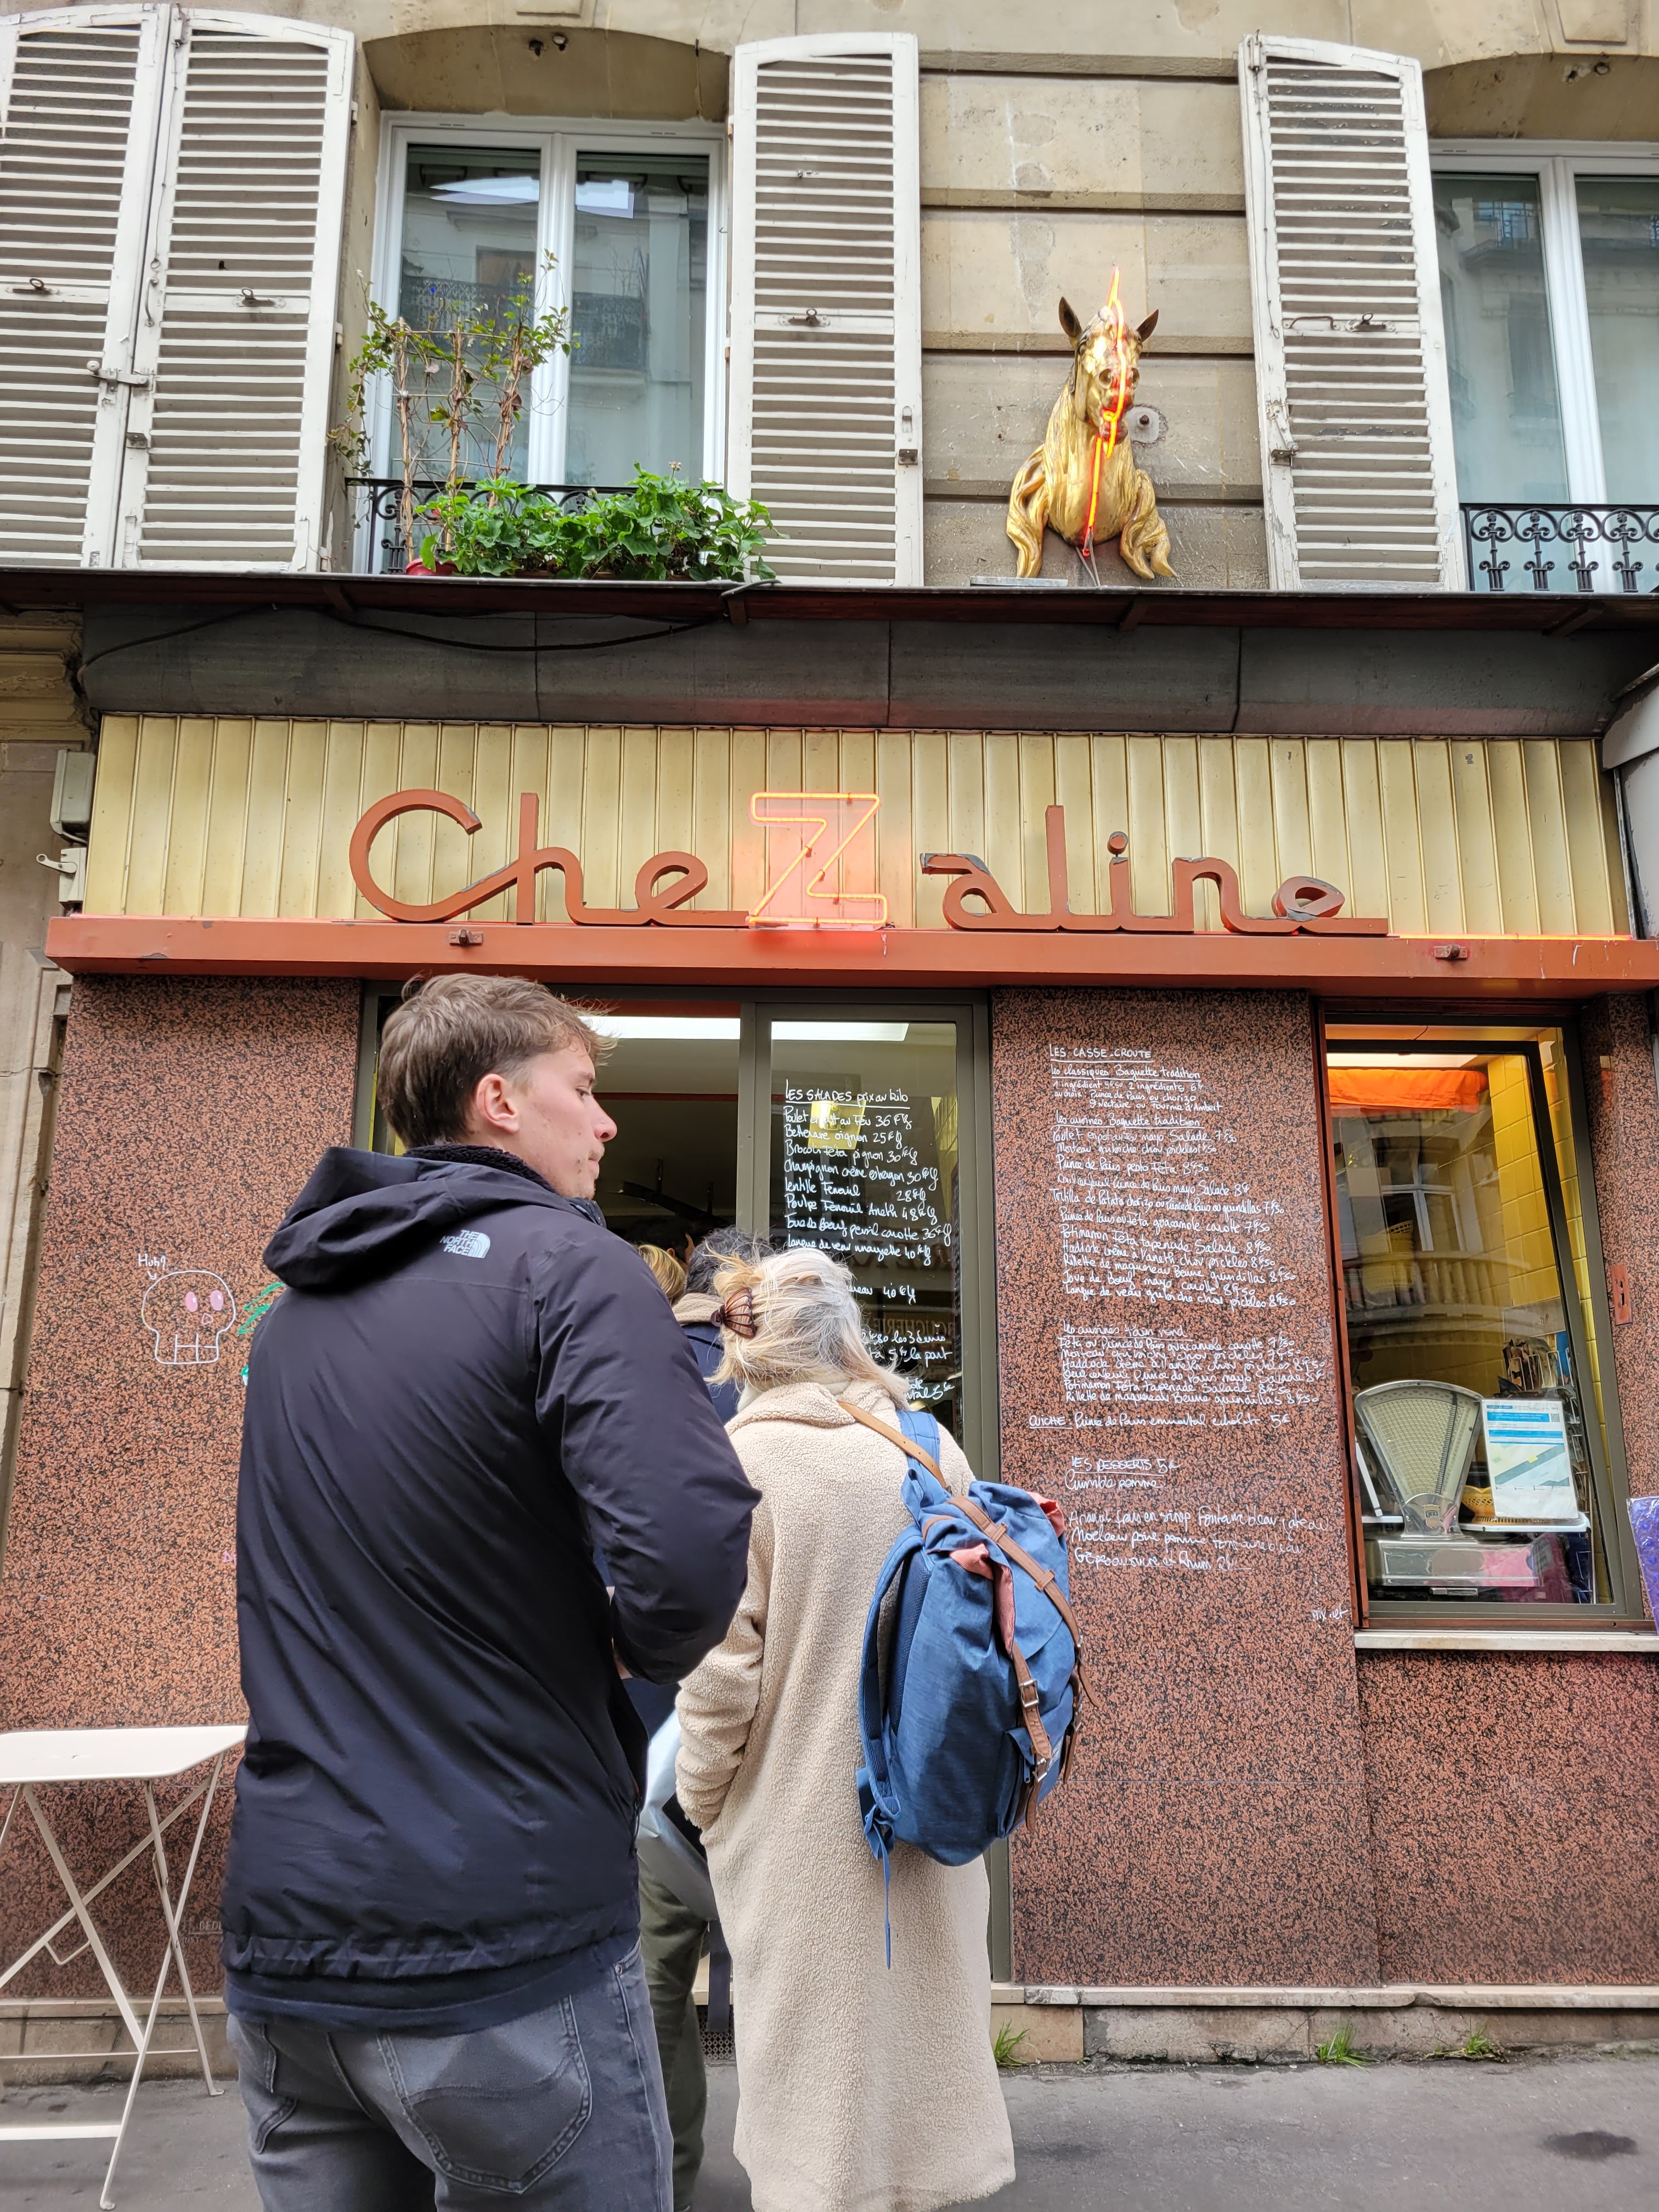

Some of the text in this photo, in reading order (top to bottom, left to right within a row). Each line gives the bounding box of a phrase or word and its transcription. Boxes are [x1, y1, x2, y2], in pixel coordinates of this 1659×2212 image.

[1049, 1043, 1066, 1058] LES
[1064, 1064, 1200, 1082] classiques Baguette tradition
[785, 1079, 909, 1108] LES SALADES prix au kilo
[1053, 1080, 1059, 1088] 1
[1060, 1080, 1103, 1092] ingrédient
[1137, 1082, 1185, 1094] ingrédients
[1098, 1099, 1131, 1108] Nectaire
[1185, 1101, 1223, 1113] d'Ambert
[1114, 1090, 1124, 1099] de
[1126, 1091, 1146, 1101] Paris
[1163, 1091, 1196, 1105] chorizo
[783, 1105, 809, 1123] Poulet
[840, 1117, 851, 1125] au
[853, 1114, 871, 1126] Feu
[1108, 1112, 1200, 1130] Baguette tradition
[784, 1123, 868, 1148] Betterave oignon
[1051, 1127, 1085, 1142] Poulet
[1142, 1133, 1164, 1146] mayo
[1169, 1130, 1212, 1142] Salade
[1057, 1142, 1198, 1156] Morteau chou pickles
[853, 1148, 883, 1169] pignon
[1085, 1158, 1098, 1170] de
[1099, 1157, 1120, 1171] Paris
[785, 1159, 905, 1187] Champignon crème estragon
[821, 1181, 861, 1197] Fenouil
[1140, 1178, 1150, 1189] de
[1173, 1185, 1196, 1199] mayo
[1197, 1180, 1229, 1197] Salade
[784, 1193, 817, 1212] Poulpe
[868, 1202, 898, 1218] Aneth
[1048, 1187, 1081, 1203] Tortilla
[1084, 1188, 1096, 1204] de
[1098, 1189, 1125, 1207] Patata
[1126, 1194, 1154, 1214] chorizo
[1212, 1203, 1221, 1211] ou
[1221, 1199, 1262, 1222] guindillas
[806, 1217, 919, 1240] de persil carotte
[1085, 1209, 1094, 1222] de
[1096, 1208, 1115, 1224] Paris
[1116, 1215, 1126, 1223] ou
[1153, 1216, 1201, 1235] guacamole
[1206, 1216, 1240, 1233] carotte
[439, 1235, 475, 1248] NORTH
[460, 1229, 480, 1240] THE
[443, 1244, 471, 1256] FACE
[819, 1239, 851, 1251] de veau
[1140, 1233, 1192, 1251] tapenade
[1194, 1238, 1240, 1255] Salade
[138, 1253, 166, 1270] Huh?
[1180, 1252, 1204, 1266] chou
[1209, 1255, 1248, 1269] pickles
[1064, 1252, 1097, 1267] Rillette
[1099, 1258, 1112, 1269] de
[1114, 1261, 1171, 1277] maquereau
[1210, 1271, 1266, 1289] guindillas
[1089, 1271, 1103, 1284] de
[1144, 1277, 1172, 1289] mayo
[1181, 1279, 1218, 1294] carotte
[1065, 1286, 1266, 1312] Langue de veau chou pickles
[891, 1330, 907, 1344] les
[907, 1330, 915, 1344] 3
[1086, 1340, 1096, 1349] ou
[1146, 1338, 1165, 1351] Paris
[1167, 1337, 1222, 1357] guacamole
[1228, 1338, 1262, 1351] carotte
[904, 1347, 922, 1363] la
[924, 1346, 953, 1368] part
[1060, 1350, 1262, 1363] Morteau chou pickles
[1063, 1359, 1111, 1373] Haddock
[1207, 1361, 1237, 1372] chou
[1143, 1380, 1197, 1396] tapenade
[1201, 1381, 1251, 1395] Salade
[1171, 1370, 1183, 1381] de
[1188, 1370, 1217, 1384] Paris
[1222, 1373, 1251, 1389] mayo
[1255, 1369, 1305, 1384] Salade
[1065, 1391, 1097, 1403] Rillette
[1100, 1391, 1111, 1402] de
[1114, 1393, 1170, 1407] maquereau
[1214, 1393, 1282, 1413] guindillas
[1105, 1414, 1117, 1426] de
[1119, 1413, 1148, 1427] Paris
[1071, 1455, 1153, 1472] LES DESSERTS
[1065, 1469, 1166, 1491] Crumble pomme
[1144, 1512, 1158, 1522] en
[1131, 1531, 1207, 1553] poire pomme
[1178, 1550, 1211, 1570] Rhum
[1329, 1603, 1349, 1621] net
